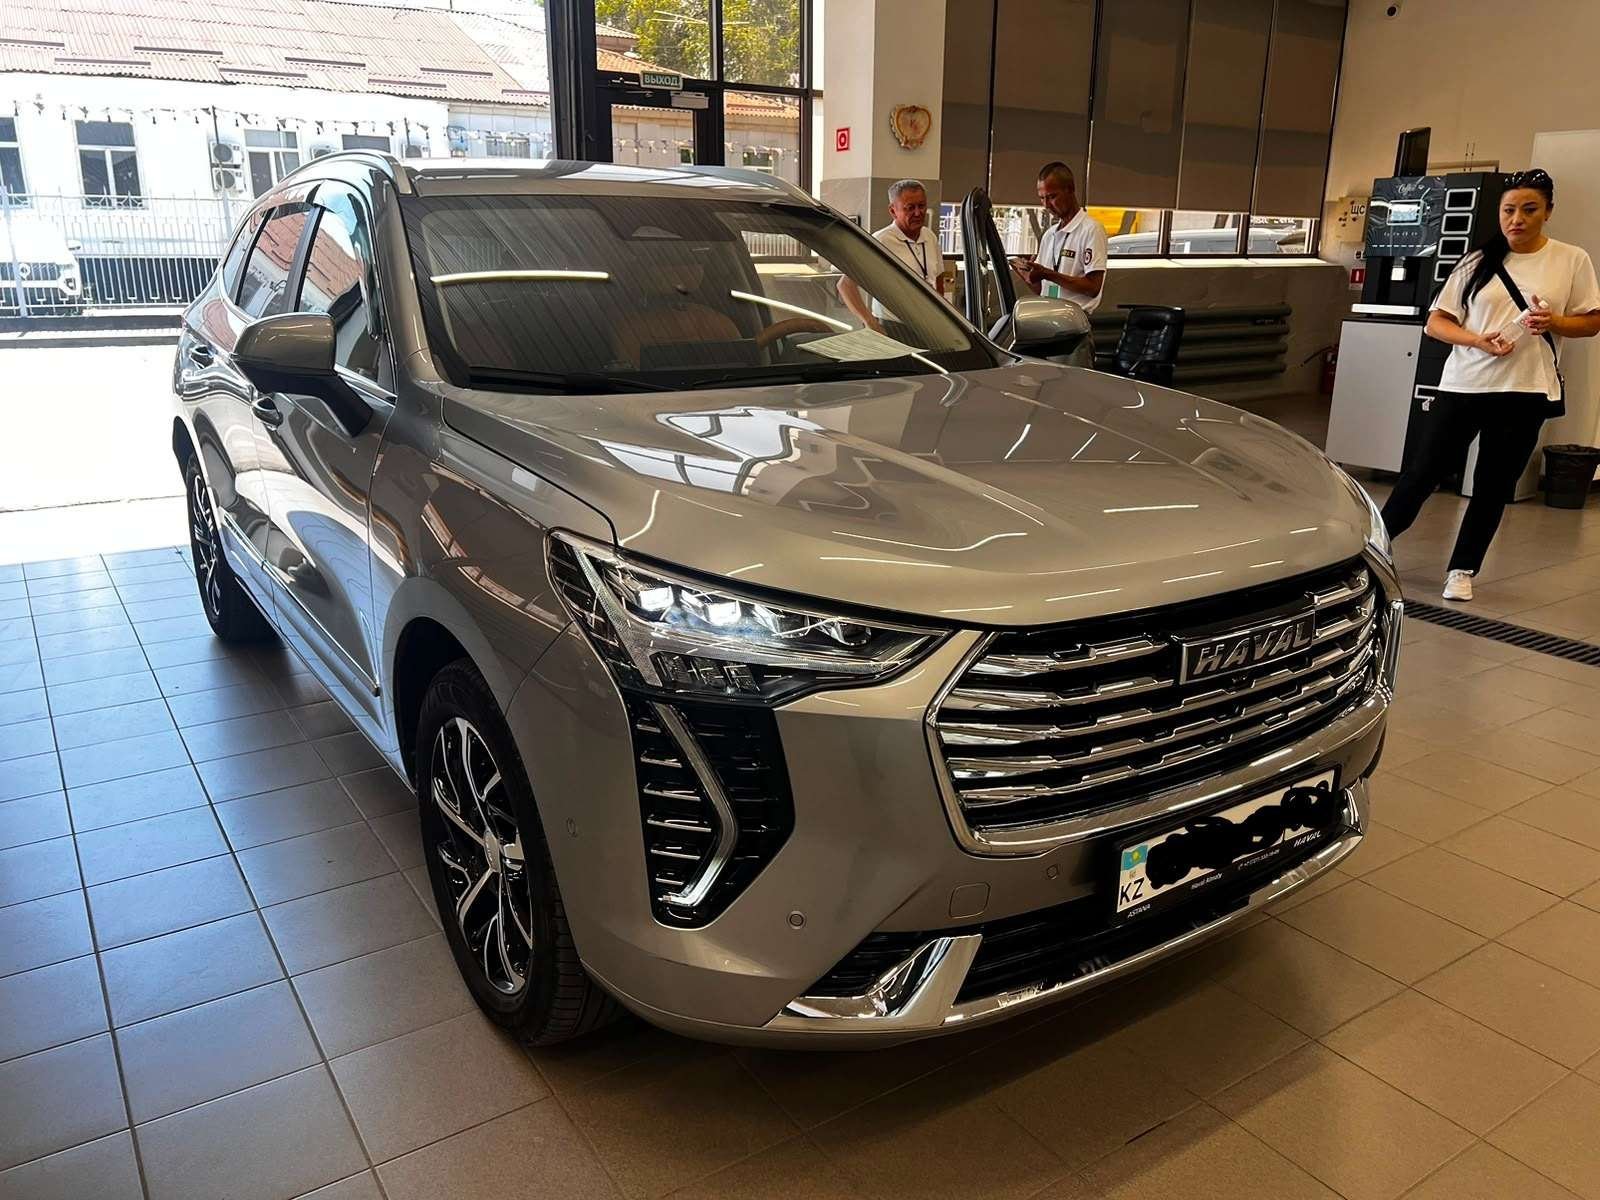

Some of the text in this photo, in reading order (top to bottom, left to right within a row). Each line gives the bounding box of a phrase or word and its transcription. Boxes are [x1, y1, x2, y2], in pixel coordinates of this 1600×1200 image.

[644, 74, 678, 86] ВЫХОД
[1193, 621, 1311, 675] HAVAL
[1119, 876, 1144, 906] KZ
